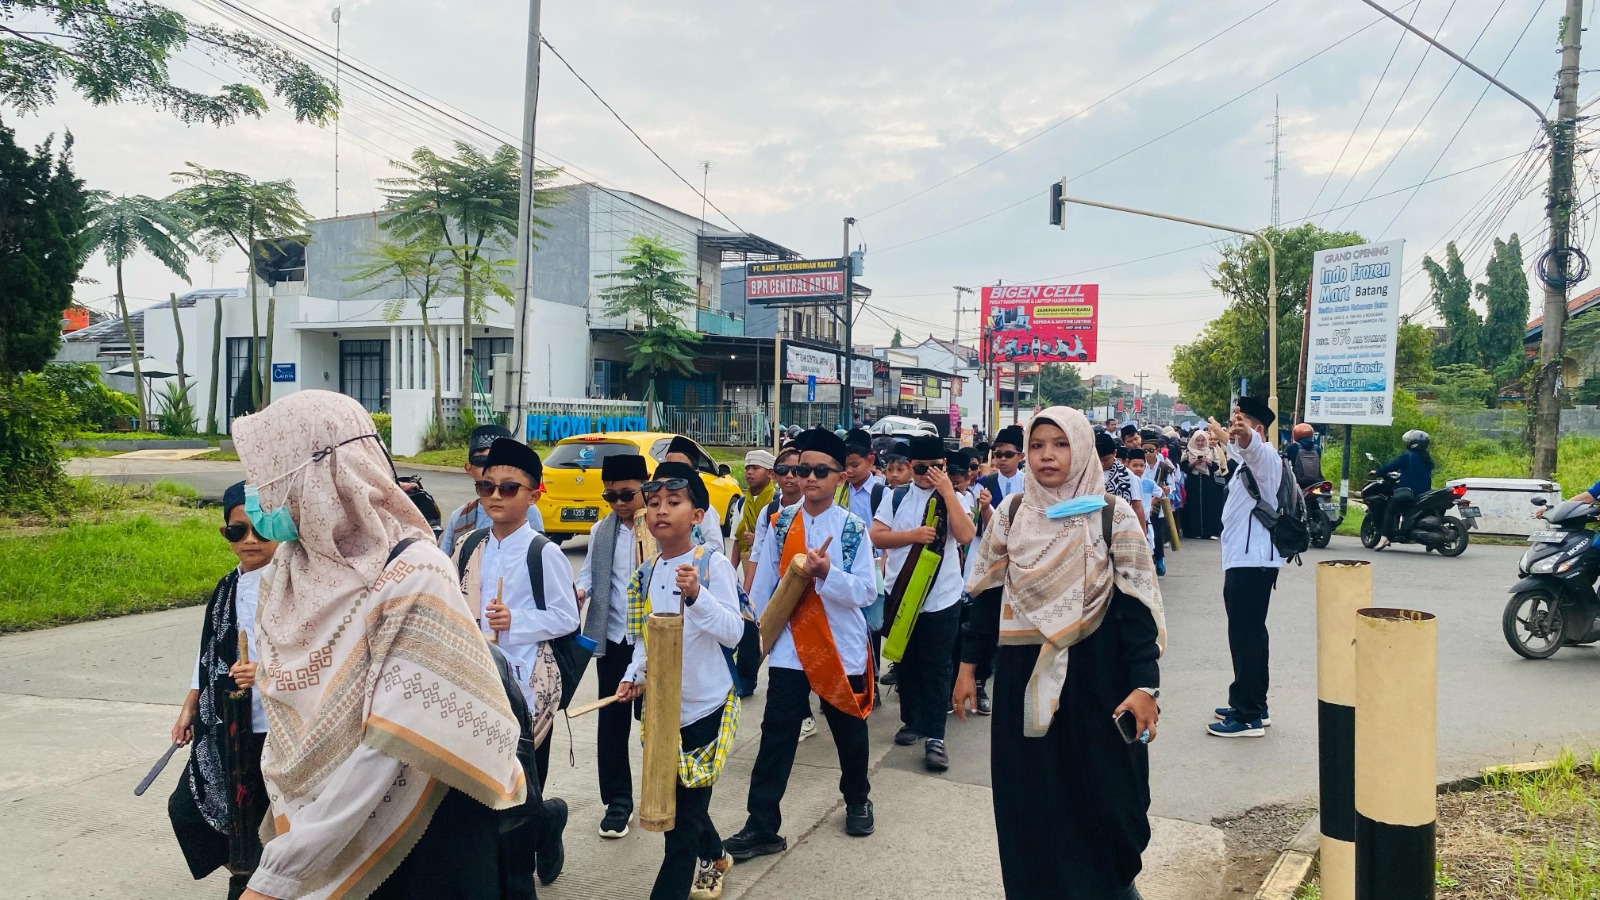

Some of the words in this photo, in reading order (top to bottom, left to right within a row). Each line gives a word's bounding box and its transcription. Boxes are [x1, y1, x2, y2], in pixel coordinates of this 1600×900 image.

[1324, 251, 1351, 264] GRAND
[1353, 246, 1388, 260] OPENING
[817, 260, 836, 269] RAKYAT
[1320, 265, 1347, 285] Indo
[1350, 262, 1390, 281] Frozen
[751, 279, 768, 294] BPR
[770, 277, 808, 294] CENTRAL
[810, 276, 839, 292] ARTHA
[989, 286, 1040, 299] BIGEN
[1042, 285, 1085, 298] CELL
[1318, 285, 1350, 304] Mart
[1356, 286, 1388, 296] Batang
[1332, 328, 1351, 346] 5%
[1315, 362, 1352, 376] Melayani
[1354, 361, 1383, 373] Grosir
[1328, 378, 1335, 388] &
[1337, 378, 1366, 388] Eceran
[527, 415, 548, 440] HE
[549, 415, 592, 440] ROYAL
[1567, 538, 1589, 556] HONDA
